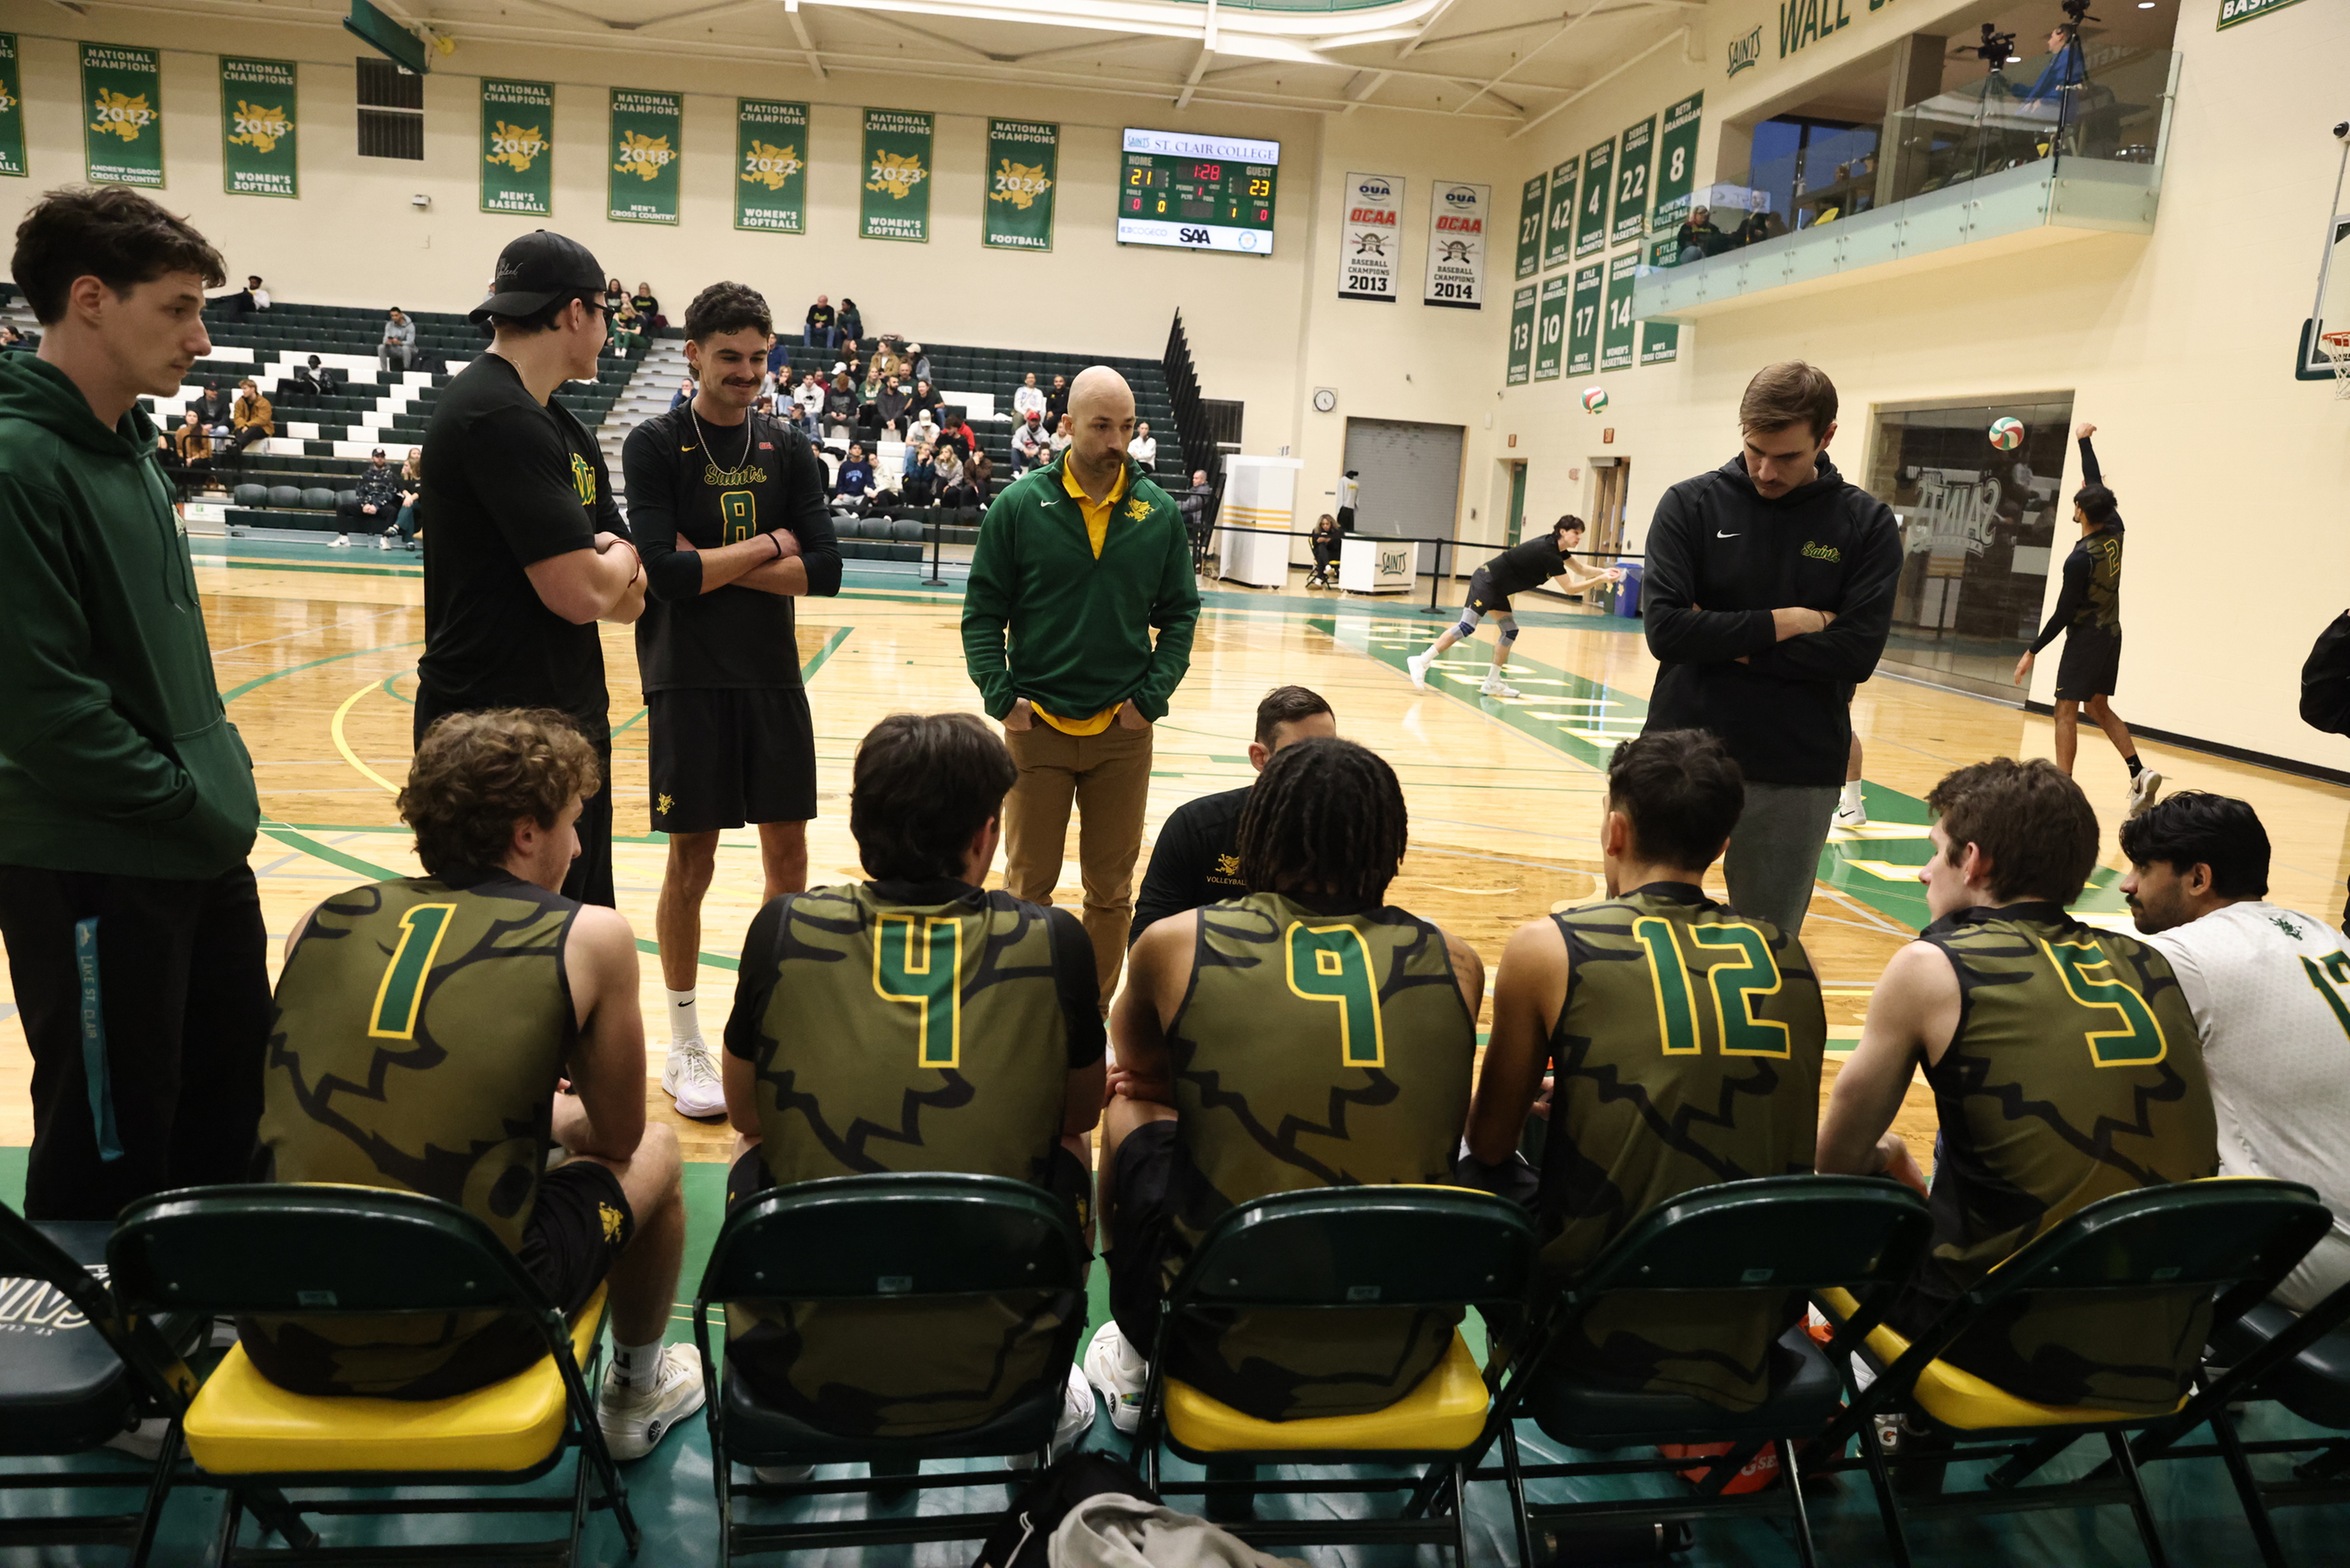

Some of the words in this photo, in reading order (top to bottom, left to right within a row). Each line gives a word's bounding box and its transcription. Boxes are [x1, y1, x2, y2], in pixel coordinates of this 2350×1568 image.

[88, 49, 151, 63] NATIONAL
[1727, 25, 1762, 74] SAINTS
[84, 59, 156, 72] CHAMPIONS
[228, 62, 288, 75] NATIONAL
[224, 72, 294, 85] CHAMPIONS
[488, 84, 546, 96] NATIONAL
[484, 92, 550, 106] CHAMPIONS
[618, 94, 674, 106] NATIONAL
[97, 106, 150, 124] 2012
[613, 103, 679, 116] CHAMPIONS
[745, 104, 802, 116] NATIONAL
[740, 112, 806, 126] CHAMPIONS
[870, 114, 926, 126] NATIONAL
[234, 118, 286, 136] 2015
[866, 122, 930, 135] CHAMPIONS
[996, 122, 1052, 135] NATIONAL
[990, 131, 1056, 144] CHAMPIONS
[492, 138, 542, 155] 2017
[1175, 142, 1213, 154] CLAIR
[1217, 146, 1275, 160] COLLEGE
[620, 147, 669, 165] 2018
[1128, 155, 1153, 167] HOME
[745, 156, 796, 174] 2022
[1246, 166, 1272, 177] GUEST
[1670, 146, 1685, 182] 8
[90, 172, 120, 181] CROSS
[122, 174, 161, 184] COUNTRY
[236, 172, 291, 184] WOMEN'S
[871, 166, 921, 183] 2023
[1131, 168, 1152, 186] 21
[1193, 164, 1221, 180] 1:28
[234, 181, 293, 194] SOFTBALL
[995, 176, 1045, 193] 2024
[1249, 179, 1270, 196] 23
[1360, 185, 1390, 196] OUA
[1621, 164, 1645, 203] 22
[500, 191, 534, 202] MEN'S
[1132, 198, 1141, 210] 0
[1446, 193, 1476, 204] OUA
[1588, 185, 1600, 215] 4
[488, 200, 546, 212] BASEBALL
[630, 204, 656, 212] MEN'S
[1157, 200, 1166, 213] 0
[611, 210, 638, 218] CROSS
[638, 212, 676, 221] COUNTRY
[745, 208, 797, 220] WOMEN'S
[1260, 209, 1268, 222] 0
[1350, 208, 1396, 226] OCAA
[1552, 199, 1571, 231] 42
[743, 218, 798, 229] SOFTBALL
[870, 217, 921, 229] WOMEN'S
[1436, 216, 1482, 233] OCAA
[1522, 212, 1540, 244] 27
[868, 226, 922, 238] SOFTBALL
[1180, 228, 1211, 244] SAA
[990, 234, 1046, 247] FOOTBALL
[1352, 258, 1388, 268] BASEBALL
[1438, 266, 1473, 275] BASEBALL
[1348, 266, 1390, 276] CHAMPIONS
[1349, 275, 1388, 292] 2013
[1434, 274, 1475, 284] CHAMPIONS
[1434, 282, 1472, 299] 2014
[1611, 296, 1630, 330] 14
[1576, 306, 1594, 337] 17
[1514, 322, 1528, 350] 13
[1542, 314, 1560, 345] 10
[704, 464, 767, 486] Saints
[720, 490, 756, 547] 8
[1382, 552, 1406, 574] SAINTS
[2103, 539, 2120, 577] 2
[80, 955, 95, 983] LAKE
[368, 903, 457, 1040] 1
[872, 913, 962, 1068] 4
[1285, 921, 1385, 1068] 9
[1632, 916, 1791, 1060] 12
[2039, 937, 2168, 1068] 5
[84, 1009, 97, 1039] CLAIR
